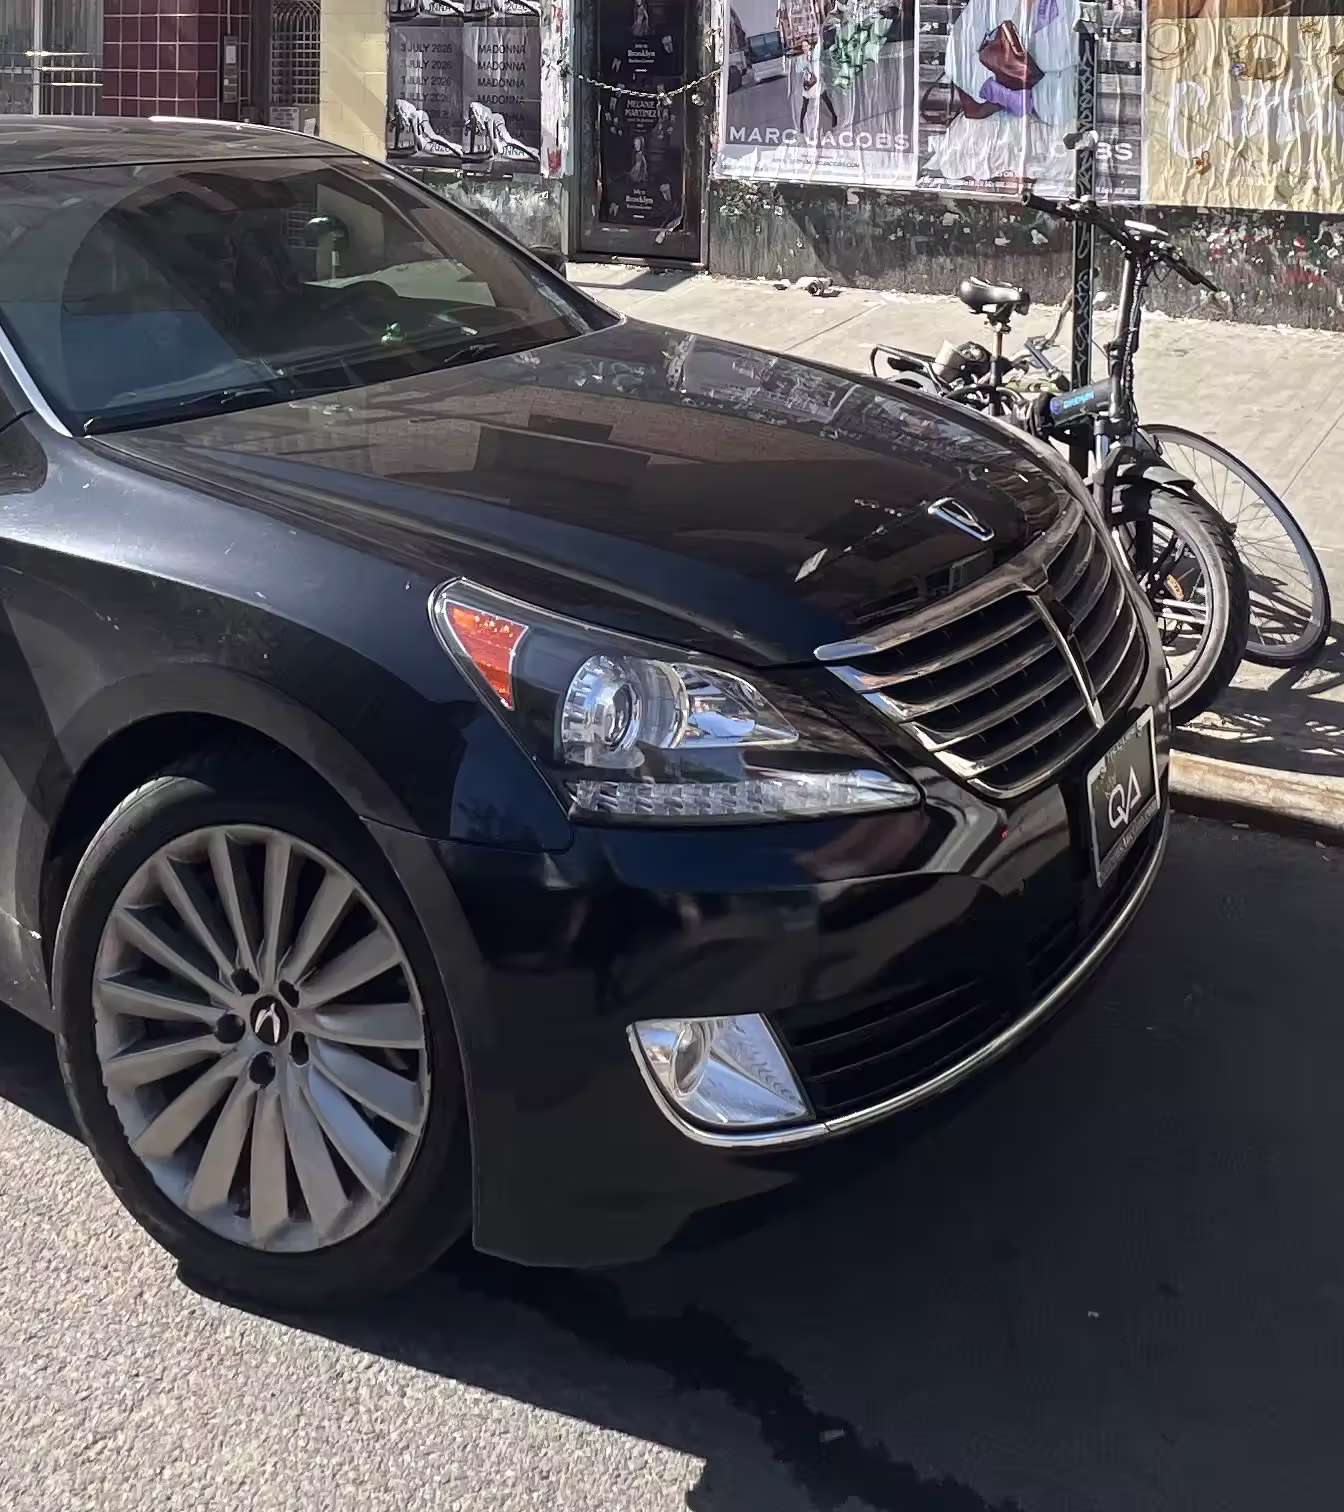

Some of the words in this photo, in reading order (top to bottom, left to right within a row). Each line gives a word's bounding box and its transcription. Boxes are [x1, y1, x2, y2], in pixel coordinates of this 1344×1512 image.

[408, 44, 429, 53] JULY
[431, 44, 452, 53] 2026
[478, 45, 525, 54] MADONNA
[628, 50, 656, 58] Brooklyn
[408, 60, 429, 69] JULY
[478, 61, 525, 71] MADONNA
[408, 76, 429, 85] JULY
[478, 78, 525, 87] MADONNA
[478, 95, 525, 104] MADONNA
[625, 108, 656, 118] MARTINEZ
[729, 126, 798, 144] MARC
[806, 131, 910, 150] JACOBS
